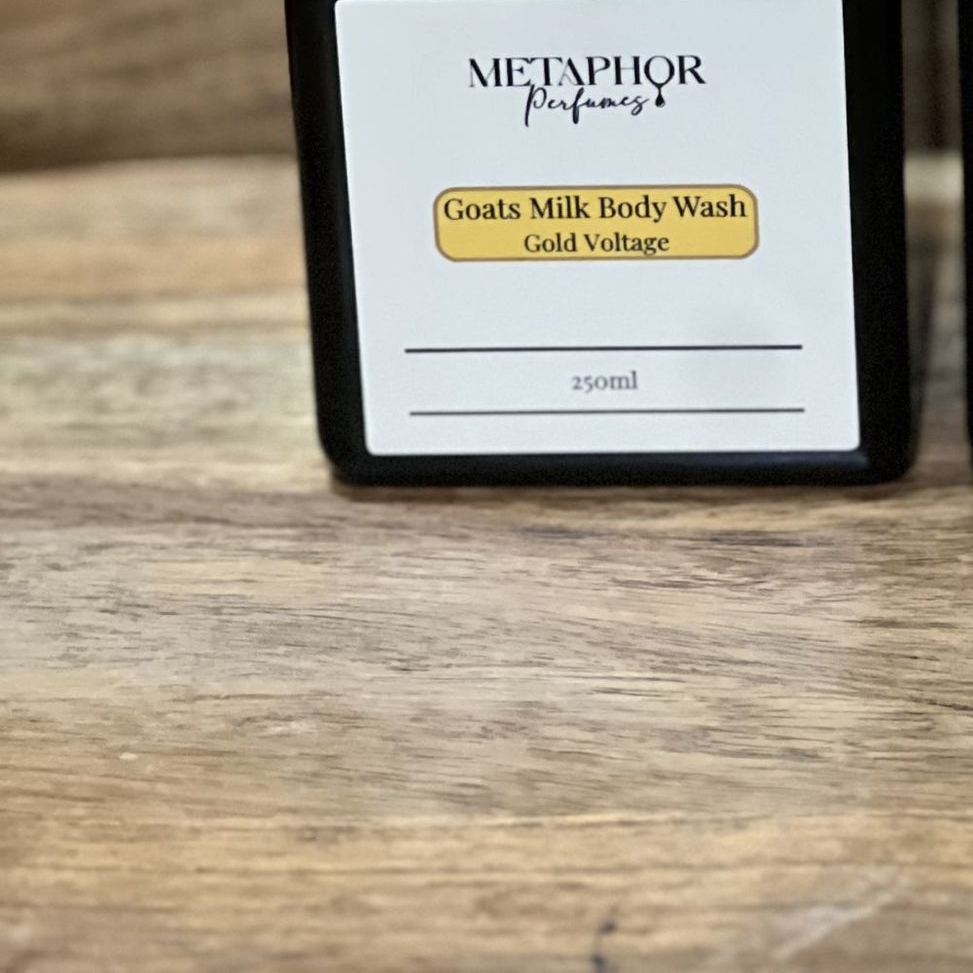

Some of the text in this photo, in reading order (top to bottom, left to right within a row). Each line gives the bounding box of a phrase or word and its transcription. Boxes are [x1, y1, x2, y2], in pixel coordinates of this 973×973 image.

[468, 55, 705, 91] METAPHOR
[523, 84, 649, 127] Perfumes
[443, 194, 746, 223] Goats Milk Body Wash
[523, 232, 670, 256] Gold Voltage
[572, 370, 637, 392] 250ml
